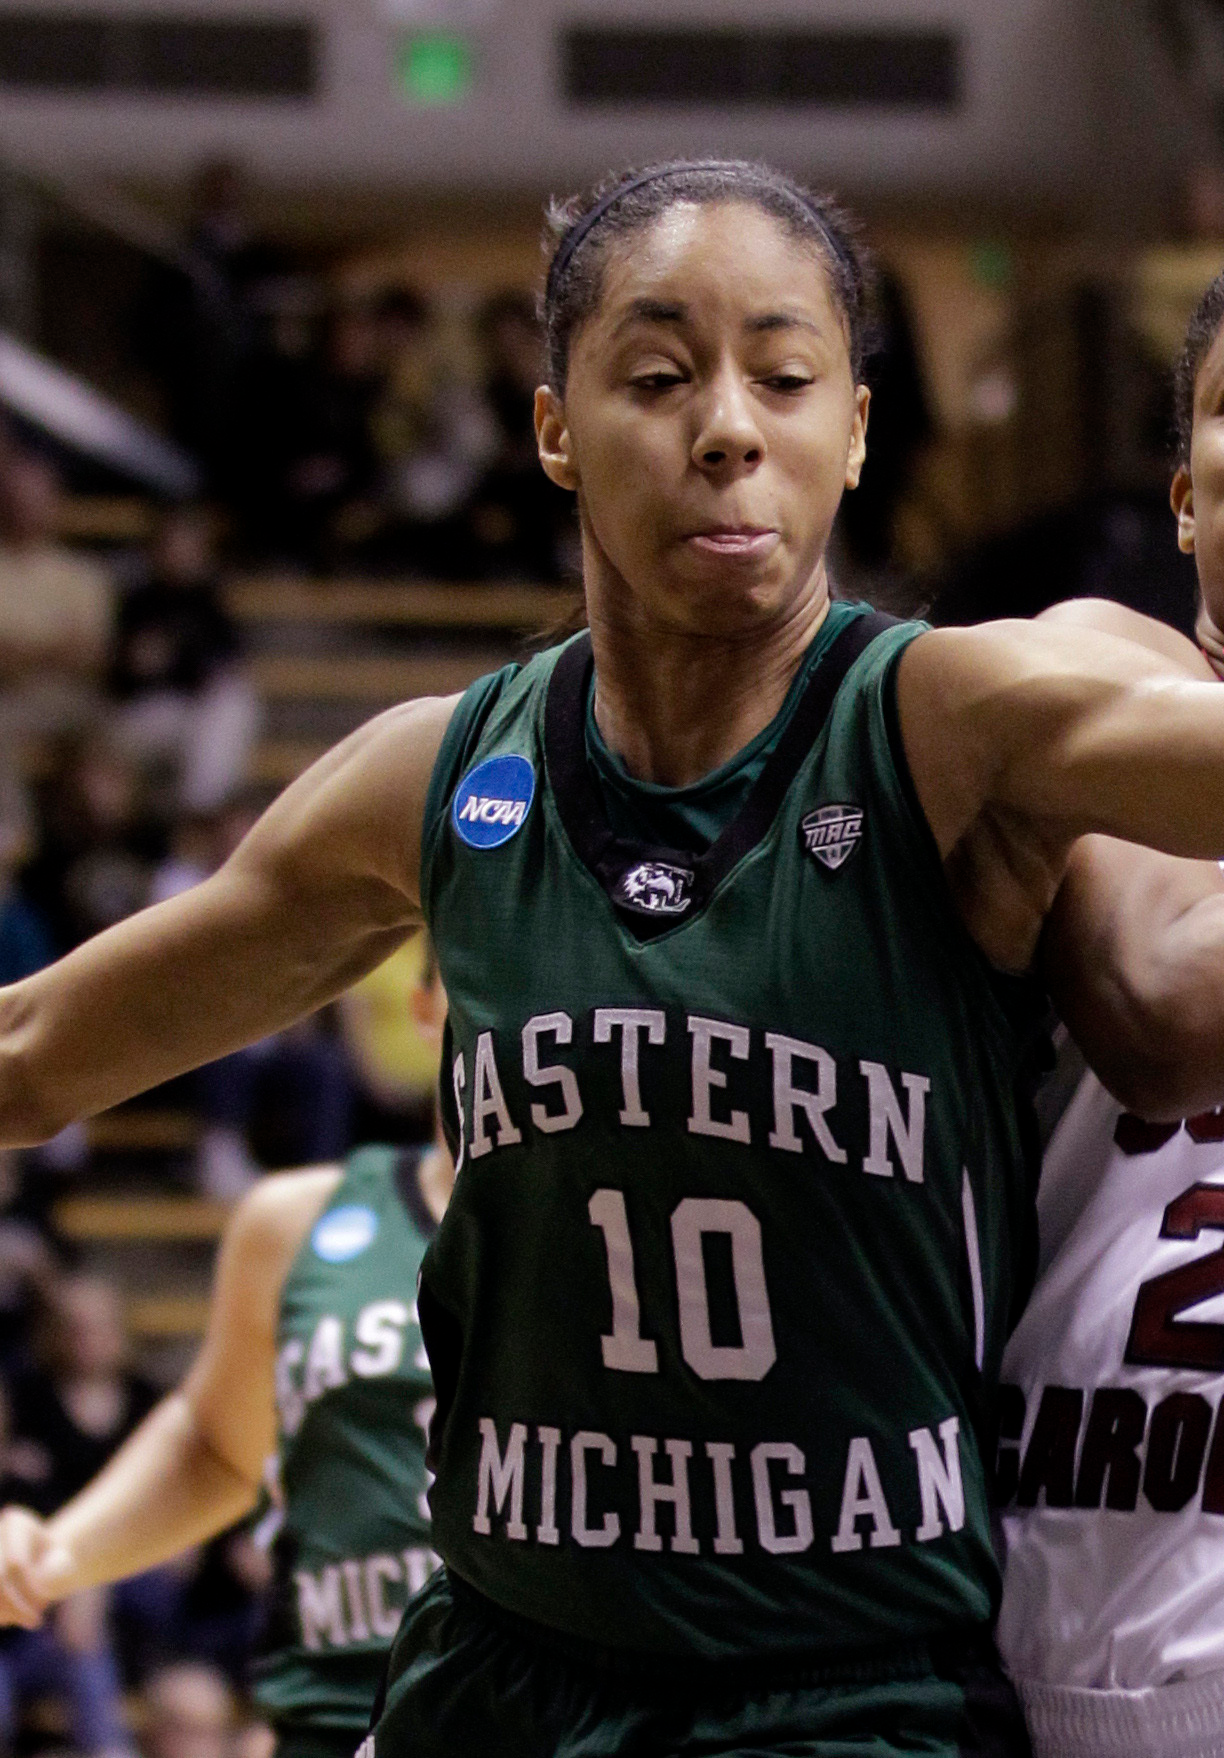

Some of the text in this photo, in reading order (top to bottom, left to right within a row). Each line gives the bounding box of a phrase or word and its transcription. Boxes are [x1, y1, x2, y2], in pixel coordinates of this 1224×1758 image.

[459, 795, 527, 826] NCAA
[805, 819, 863, 849] MAC
[587, 1188, 778, 1381] 10
[275, 1299, 433, 1436] EAS
[472, 1416, 967, 1555] MICHIGAN
